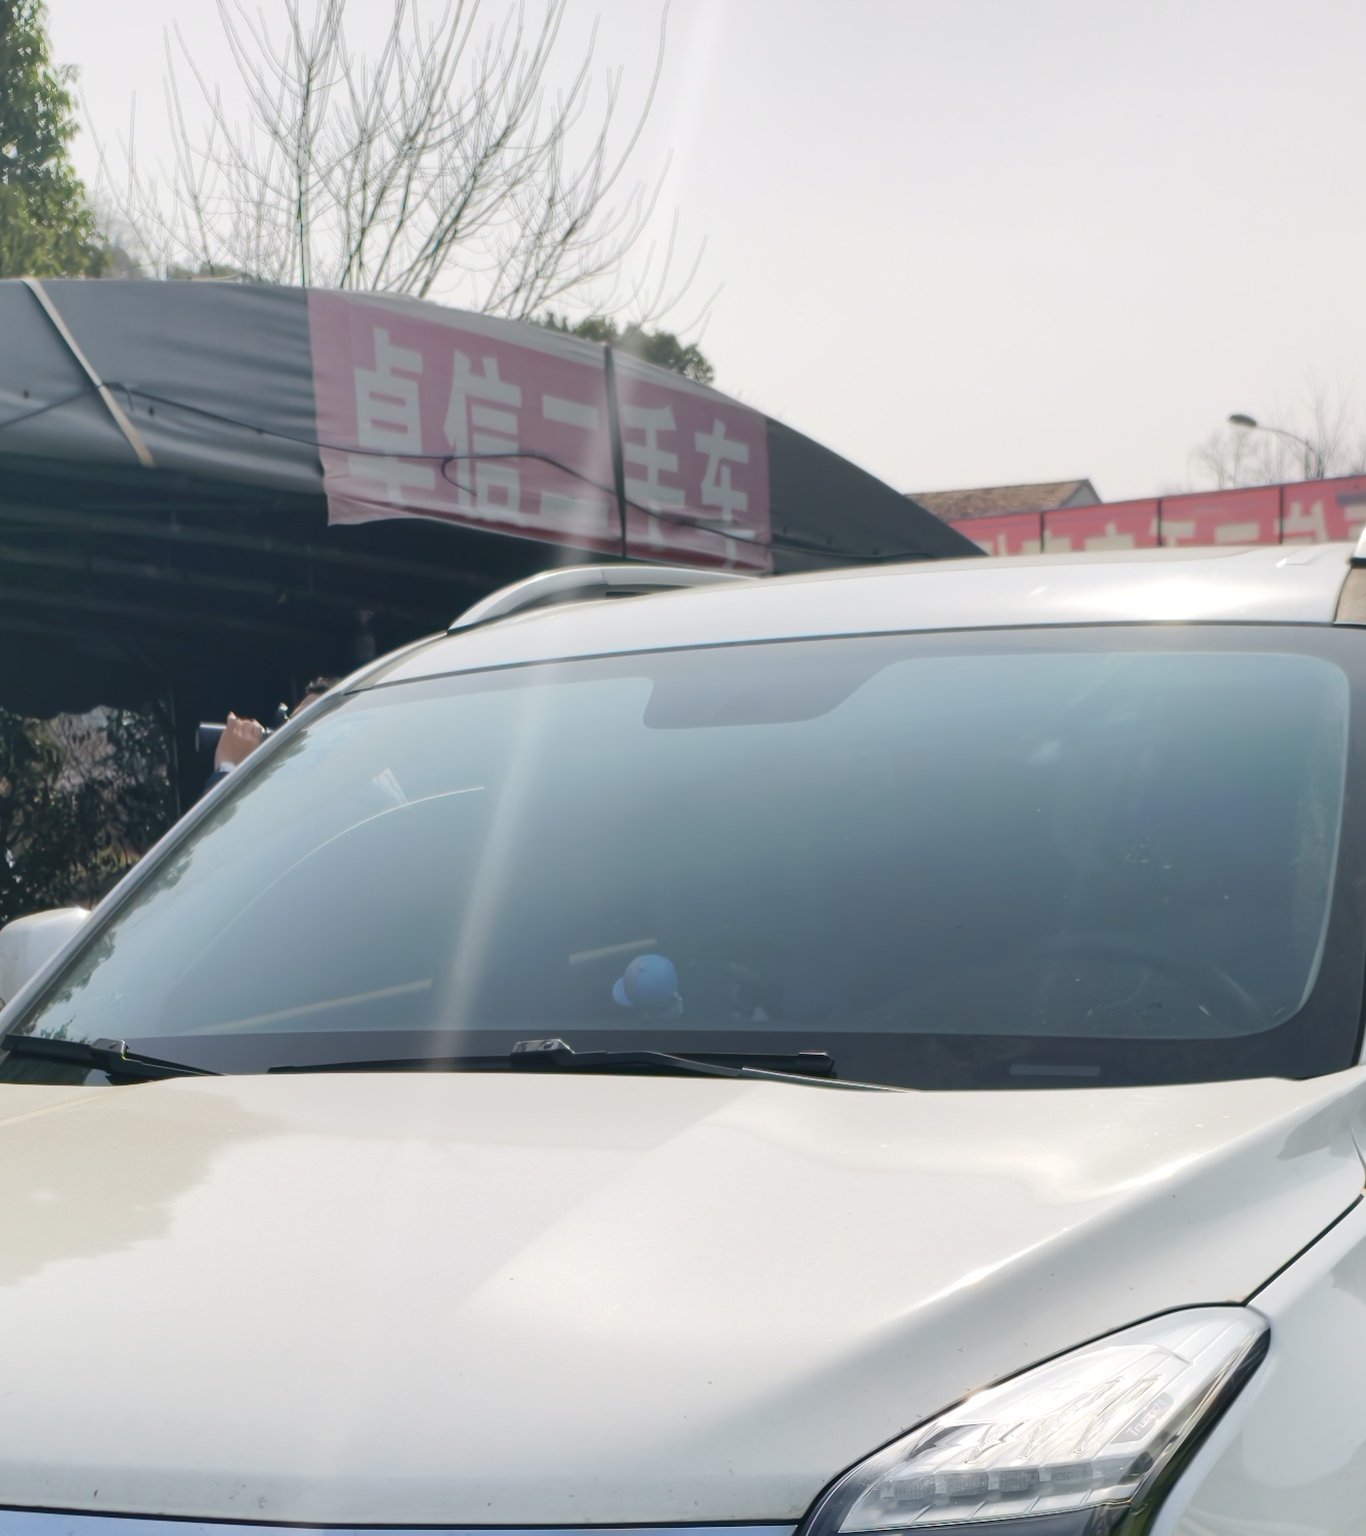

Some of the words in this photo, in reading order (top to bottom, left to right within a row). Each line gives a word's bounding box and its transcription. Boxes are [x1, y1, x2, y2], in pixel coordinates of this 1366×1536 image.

[346, 326, 756, 569] 卓信二手车
